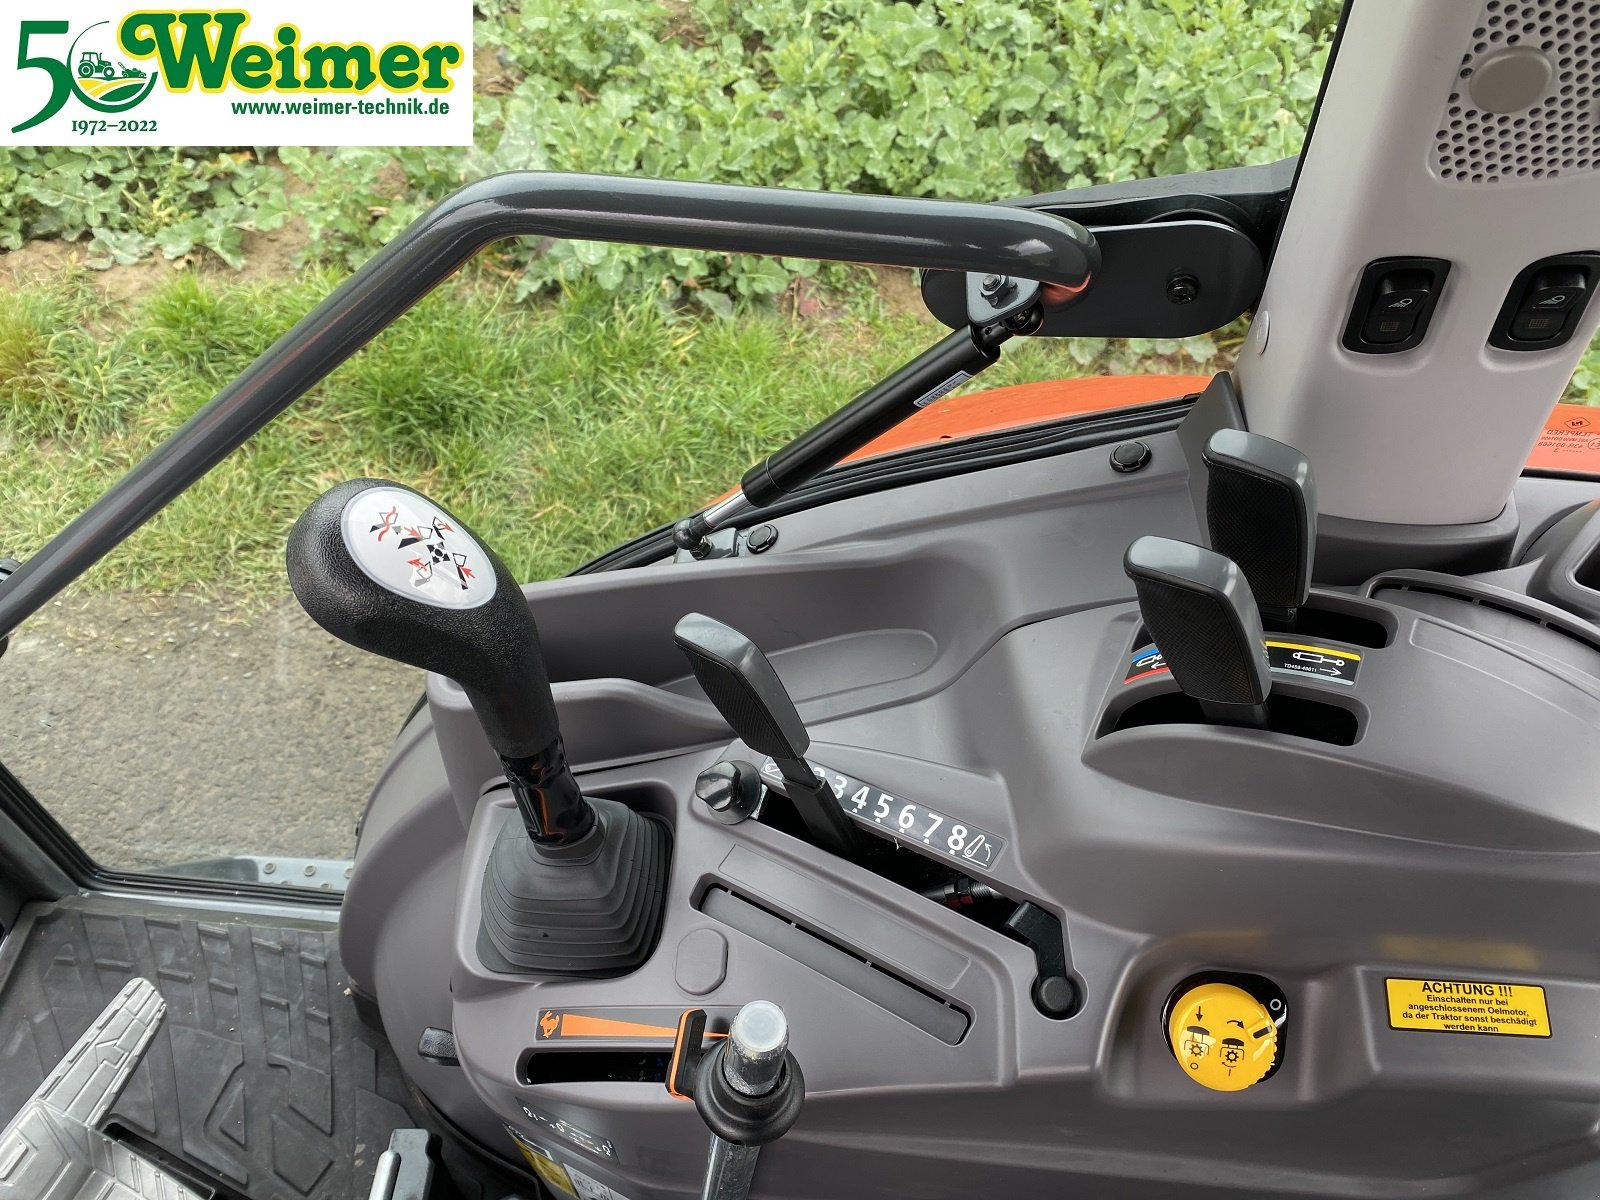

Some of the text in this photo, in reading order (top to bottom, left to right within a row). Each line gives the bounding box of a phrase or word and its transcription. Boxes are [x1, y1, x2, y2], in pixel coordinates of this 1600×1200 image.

[833, 775, 968, 851] 3 4 5 6 7 8
[1421, 982, 1513, 998] ACHTUNG !!!
[1426, 994, 1477, 1004] Einschalten
[1495, 997, 1509, 1006] bei
[1408, 1003, 1529, 1017] angeschlossenem Oelmotor,
[1402, 1011, 1538, 1027] da der Traktor sonst beschädigt
[1443, 1022, 1499, 1033] werden kann
